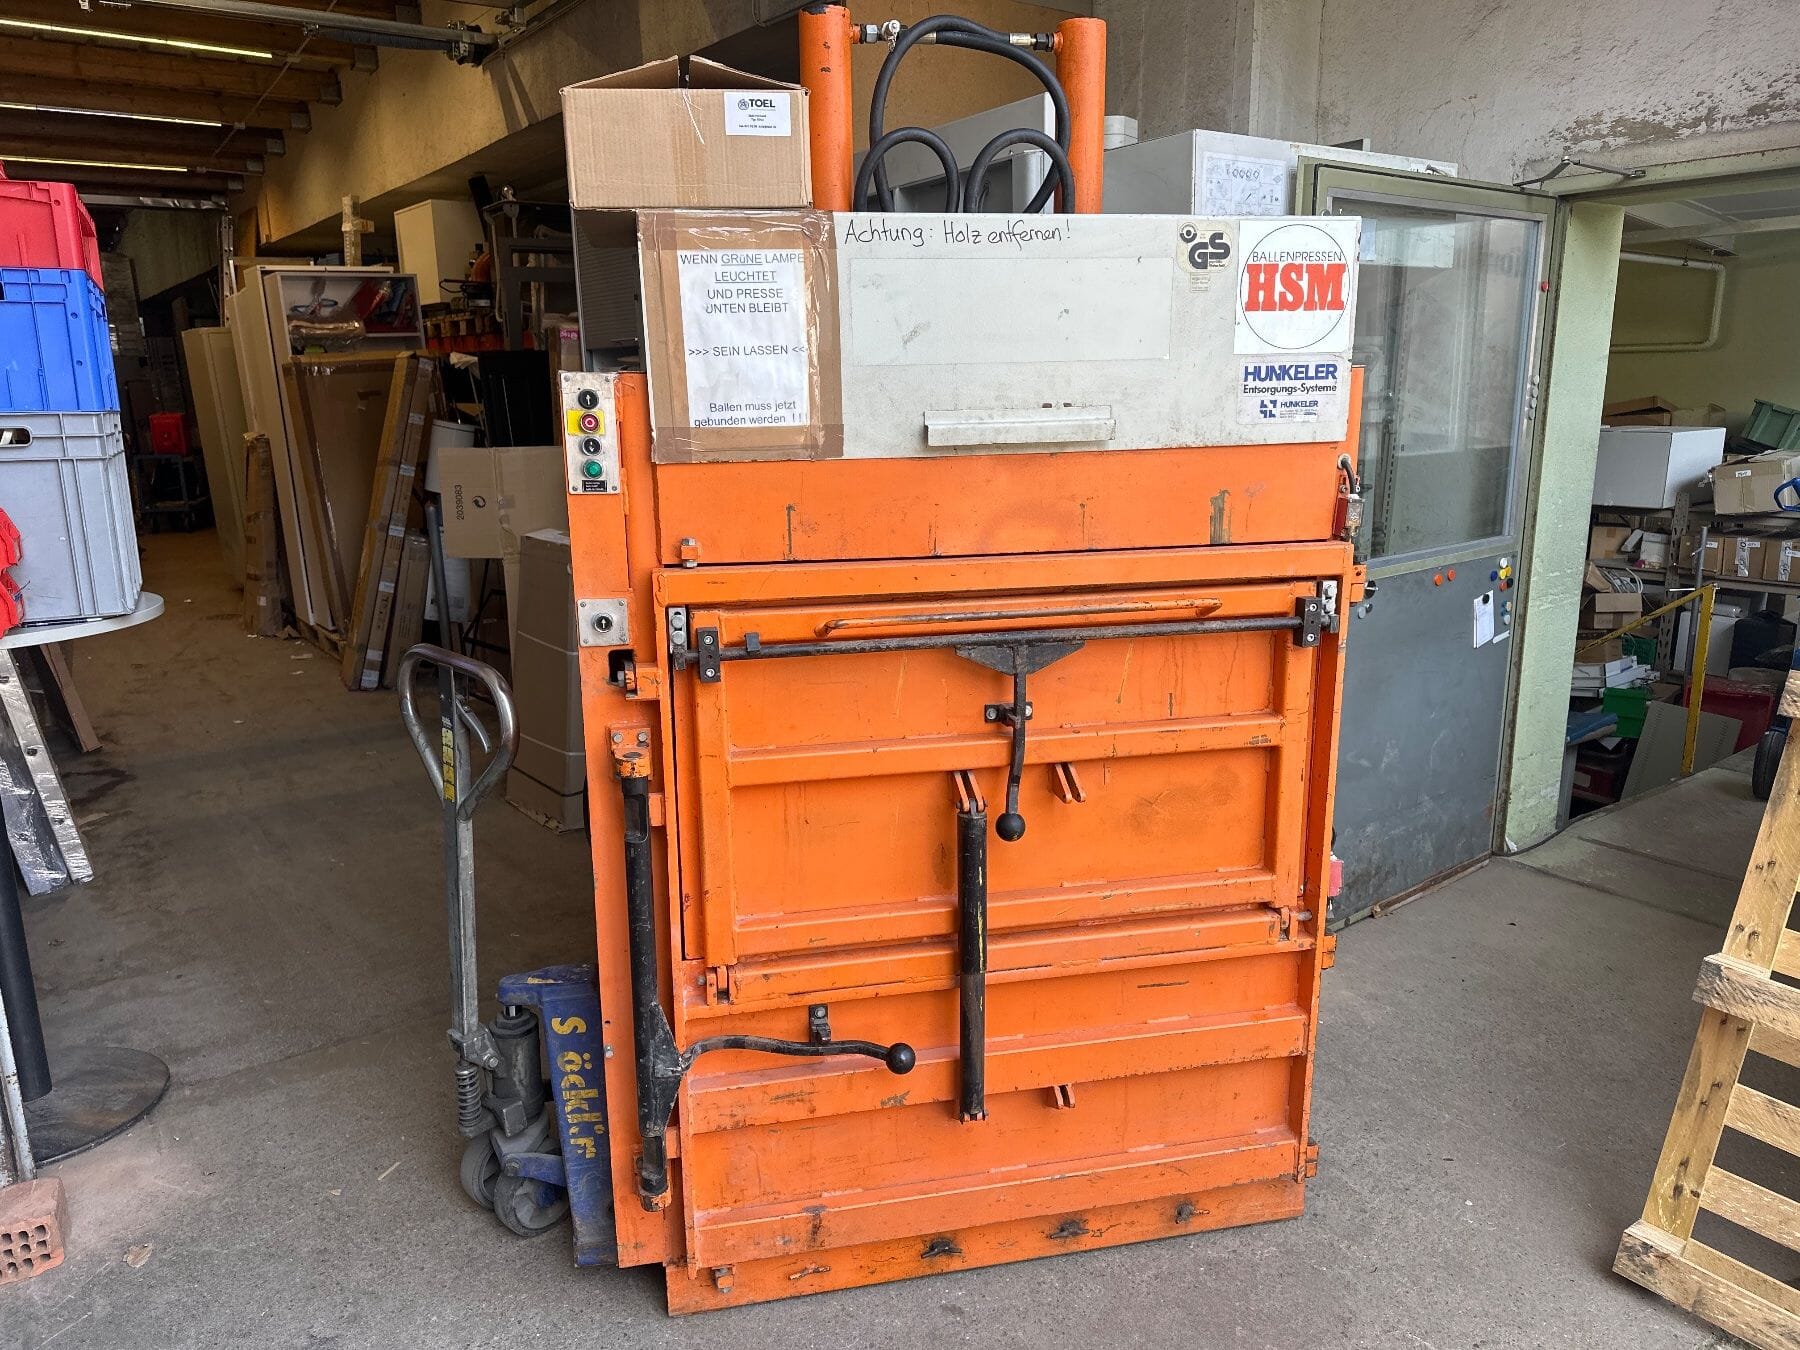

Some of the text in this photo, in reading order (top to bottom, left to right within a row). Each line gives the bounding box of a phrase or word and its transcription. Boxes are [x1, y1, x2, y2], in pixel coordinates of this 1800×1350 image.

[748, 98, 776, 108] TOEL
[844, 219, 1072, 250] Achtung: Holz entfernen!
[680, 254, 718, 265] WENN
[765, 253, 804, 264] LAMPE
[1252, 251, 1342, 262] BALLENPRESSEN
[714, 270, 777, 282] LEUCHTET
[1245, 262, 1346, 311] HSM
[707, 288, 784, 300] UND PRESSE
[705, 302, 789, 314] UNTEN BLEIBT
[712, 345, 740, 357] SEIN
[743, 344, 788, 356] LASSEN
[1243, 363, 1338, 382] HUNKELER
[1243, 383, 1337, 396] Entsorgungs-Systeme
[709, 401, 796, 413] Ballen muss jetzt
[1280, 400, 1319, 408] HUNKELER
[694, 413, 746, 428] gebunden
[749, 414, 786, 425] werden
